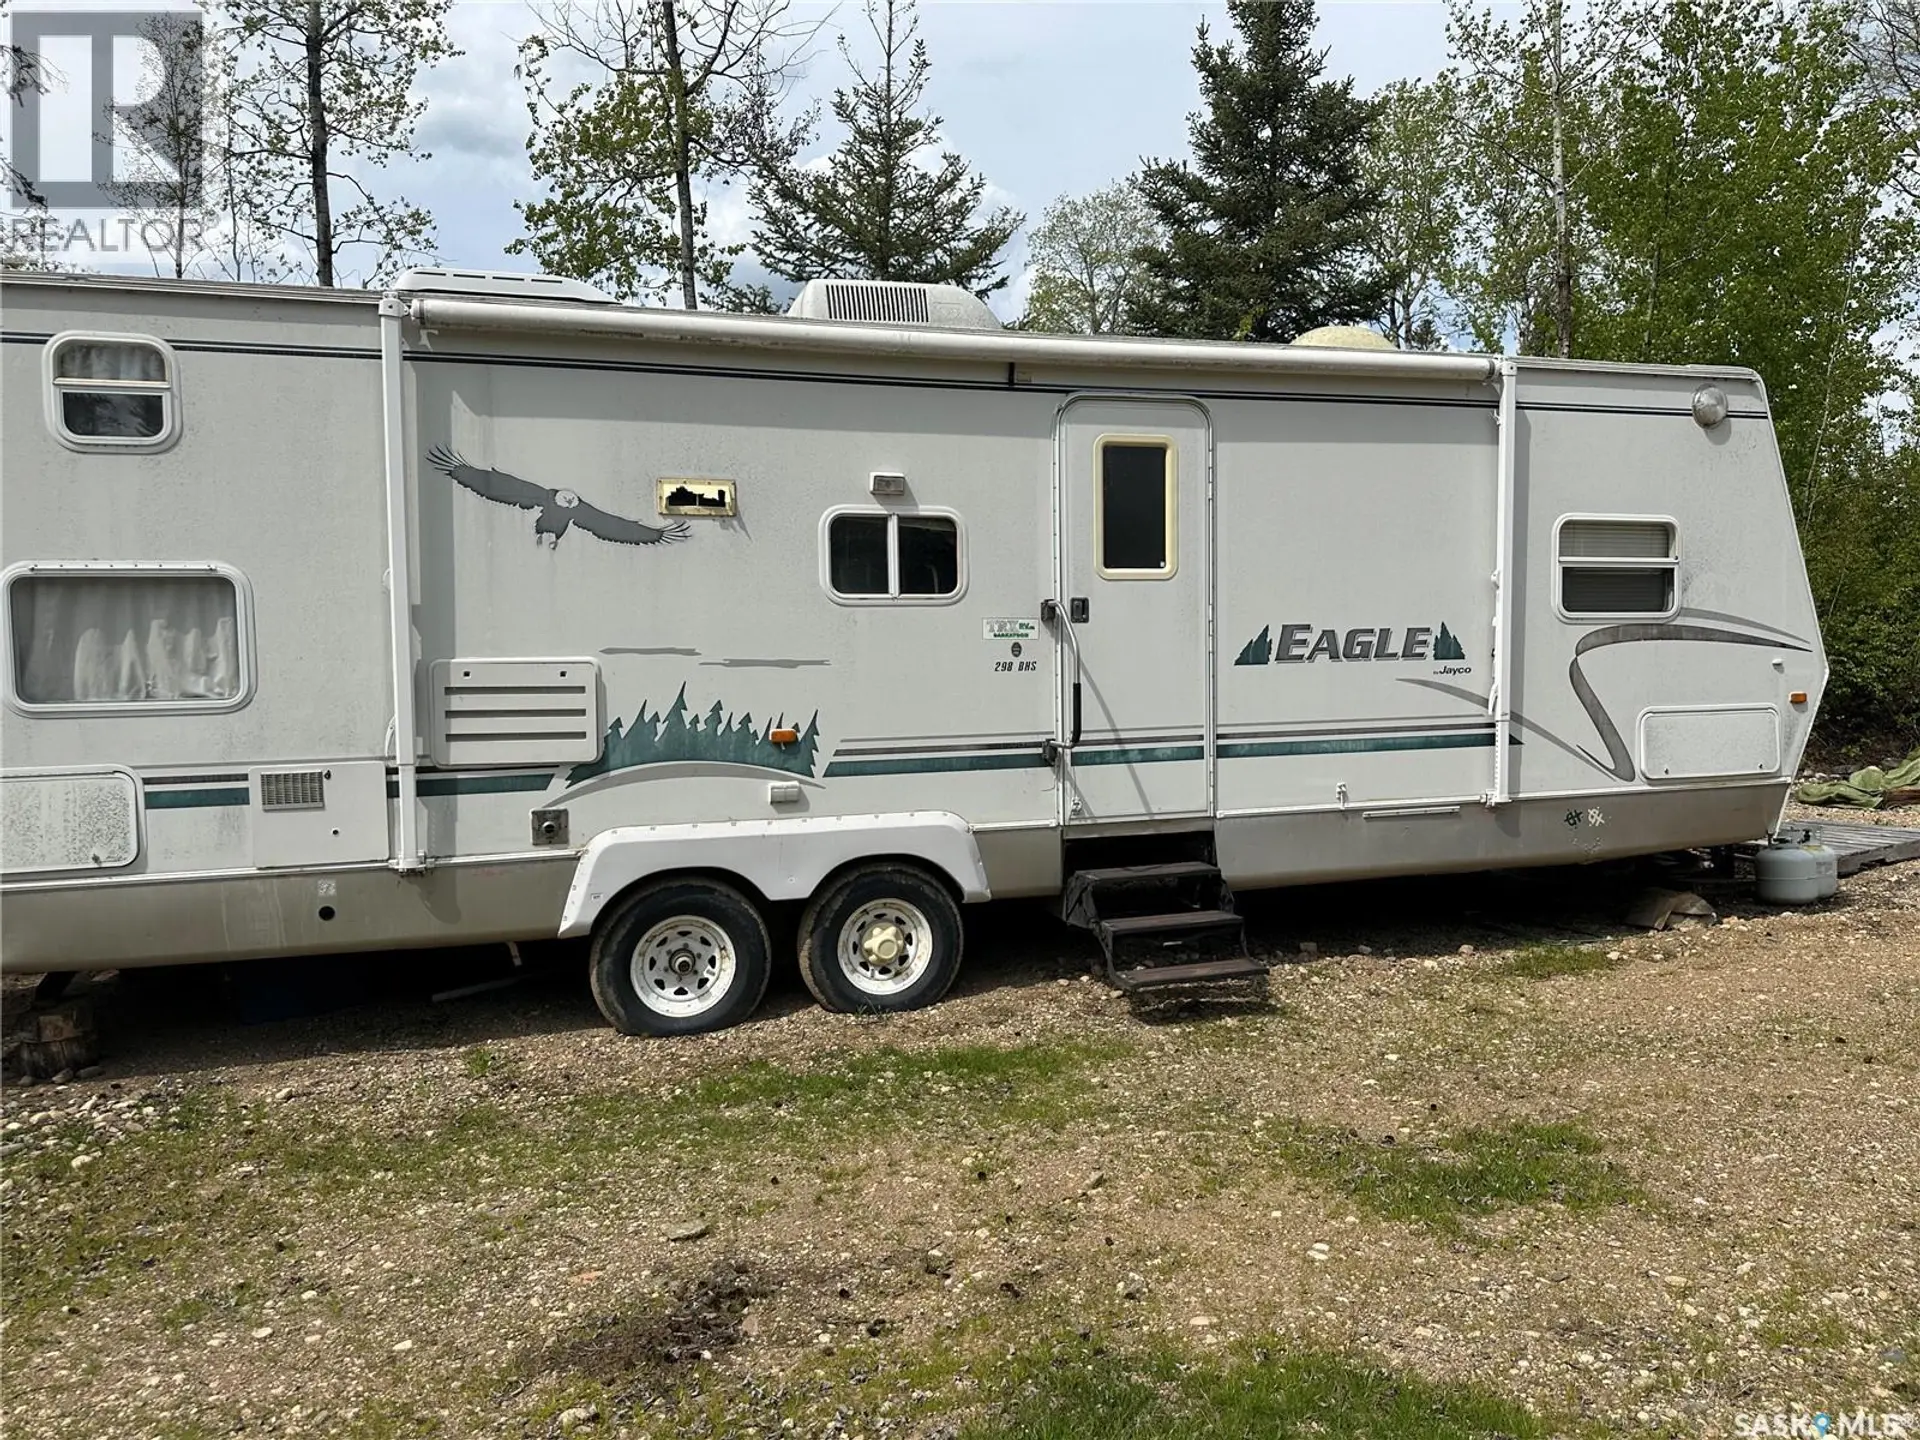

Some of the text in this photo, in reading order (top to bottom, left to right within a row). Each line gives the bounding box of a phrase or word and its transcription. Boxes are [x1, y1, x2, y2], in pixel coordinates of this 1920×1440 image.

[1275, 624, 1432, 663] EAGLE
[994, 660, 1037, 672] 298 BHS
[1438, 665, 1472, 676] Jayco
